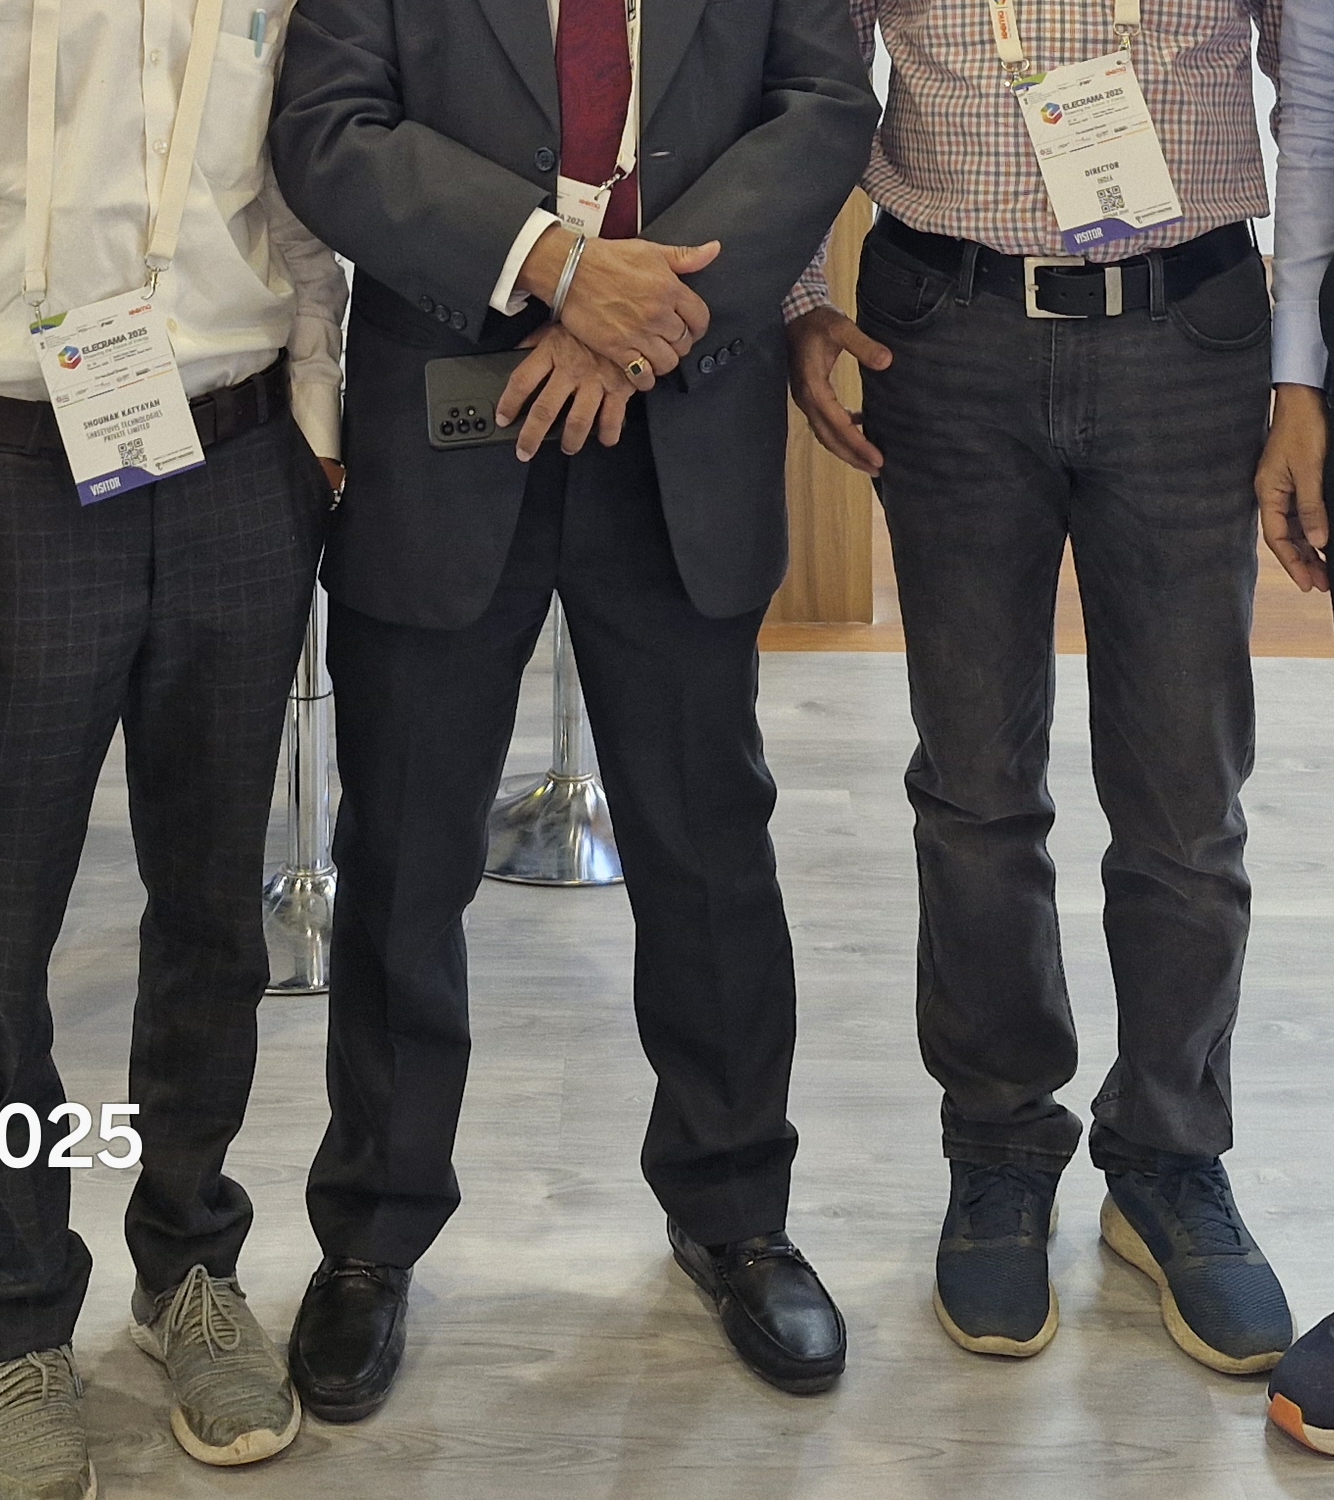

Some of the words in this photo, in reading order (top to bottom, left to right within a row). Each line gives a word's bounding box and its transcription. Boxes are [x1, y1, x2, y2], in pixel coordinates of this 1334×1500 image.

[1084, 161, 1120, 177] DIRECTOR
[1074, 227, 1104, 244] VISITOR
[127, 326, 148, 340] 2025
[83, 411, 120, 430] SHOUNAK
[90, 476, 122, 496] VISITOR
